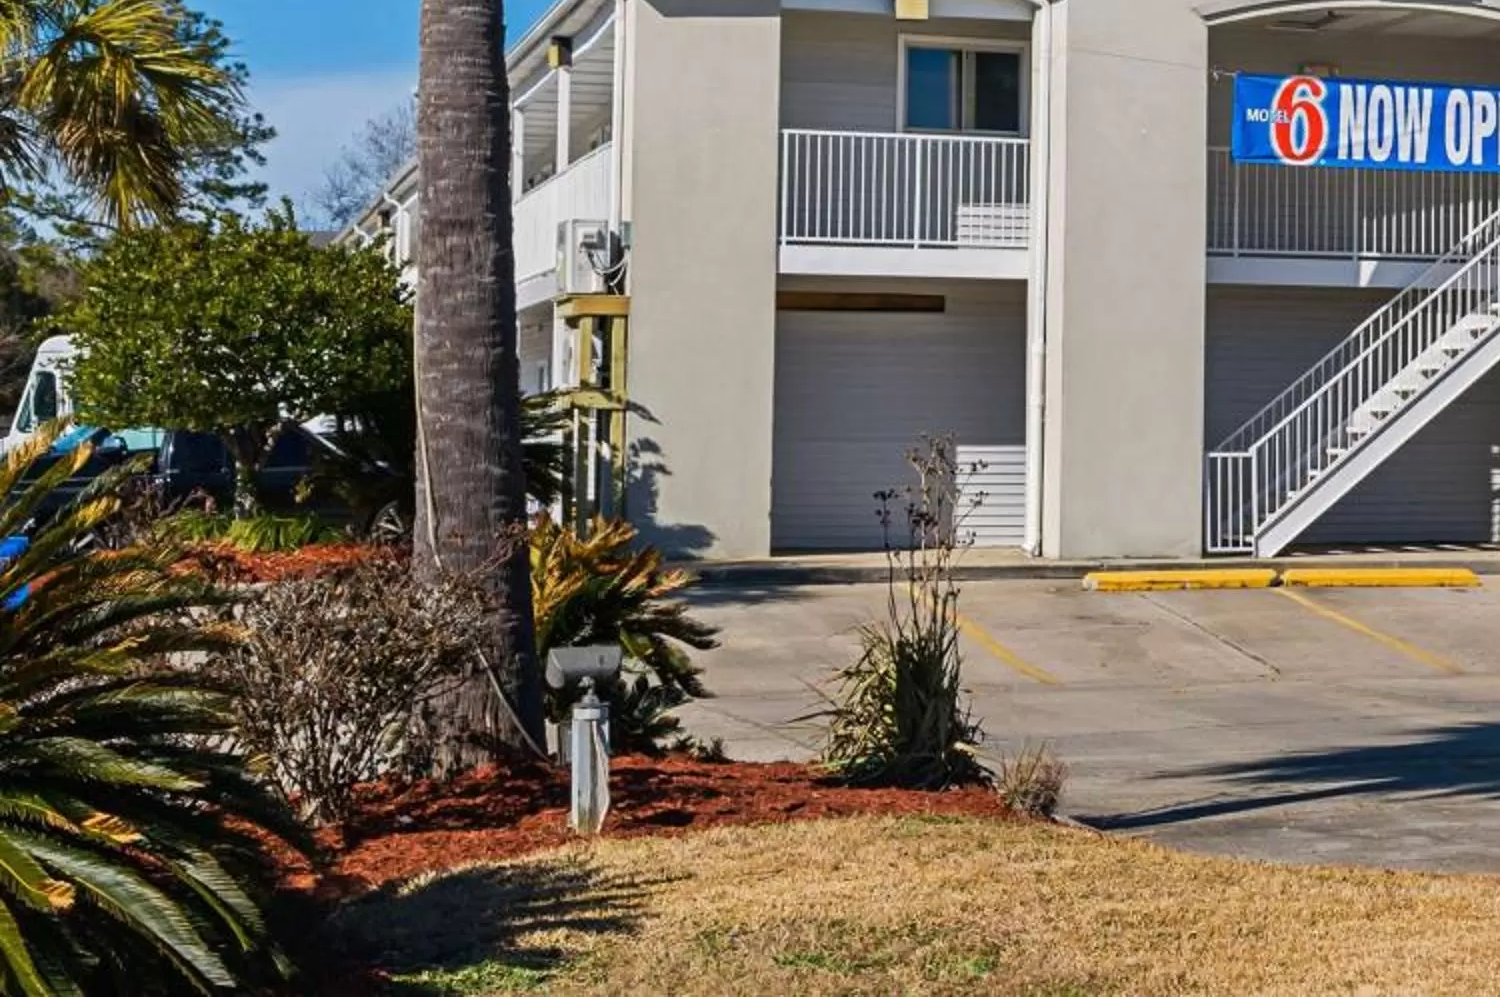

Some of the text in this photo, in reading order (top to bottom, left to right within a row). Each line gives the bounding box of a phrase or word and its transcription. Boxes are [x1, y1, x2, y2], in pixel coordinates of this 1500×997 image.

[1246, 107, 1290, 124] MOTEL
[1271, 75, 1328, 166] 6
[1338, 84, 1433, 165] NOW
